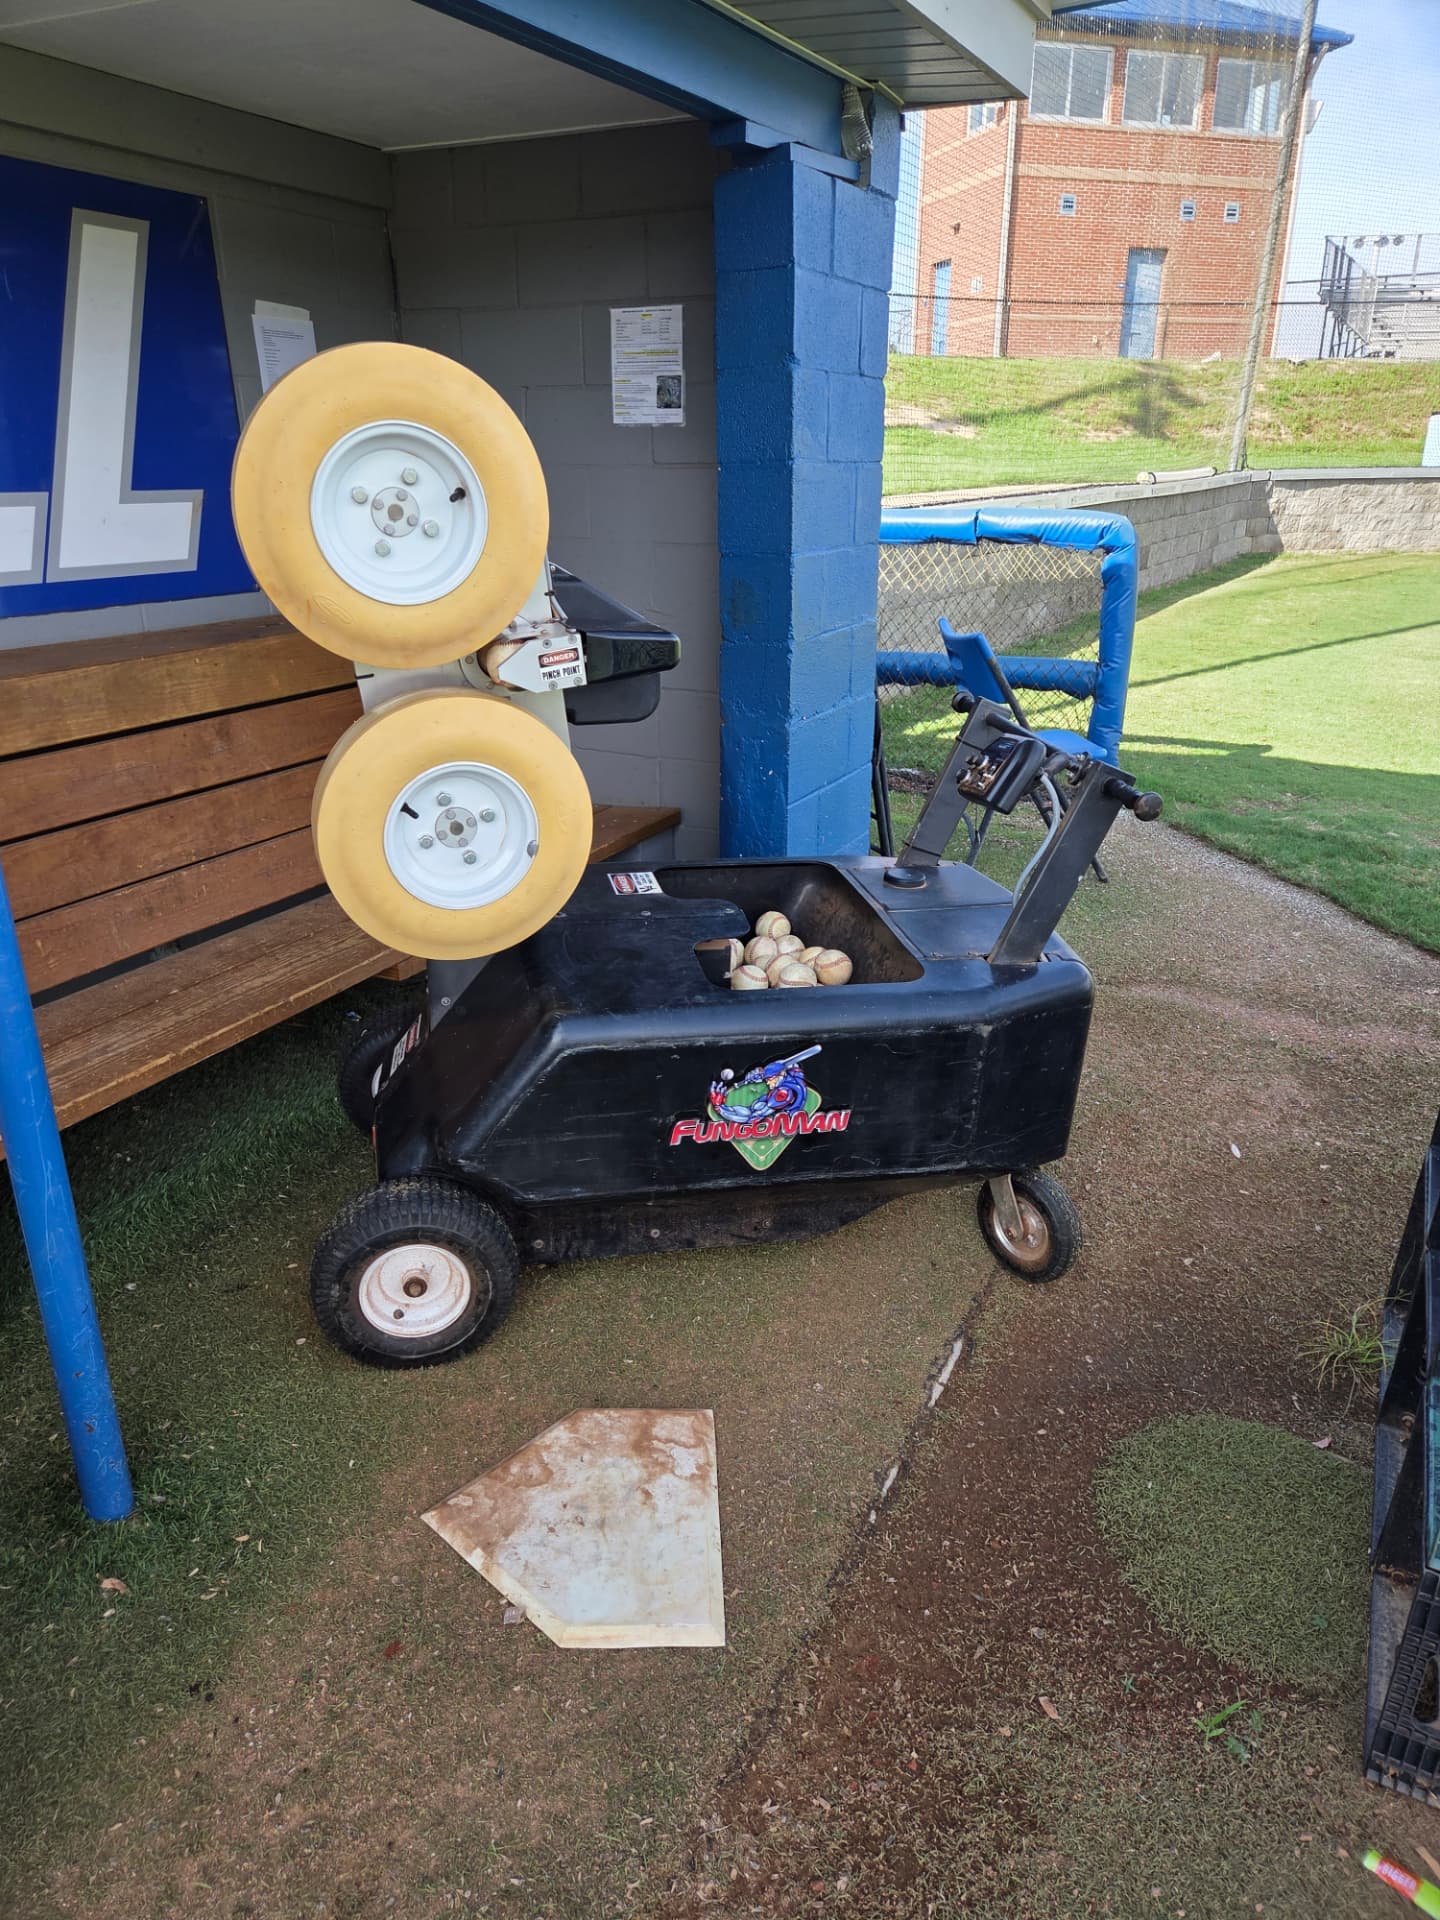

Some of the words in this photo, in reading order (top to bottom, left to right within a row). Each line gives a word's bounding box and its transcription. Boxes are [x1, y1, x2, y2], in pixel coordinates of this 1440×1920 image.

[543, 652, 575, 664] DANGER
[542, 669, 560, 680] PINCH
[562, 665, 581, 676] POINT
[670, 1109, 851, 1146] FUNGOMAN
